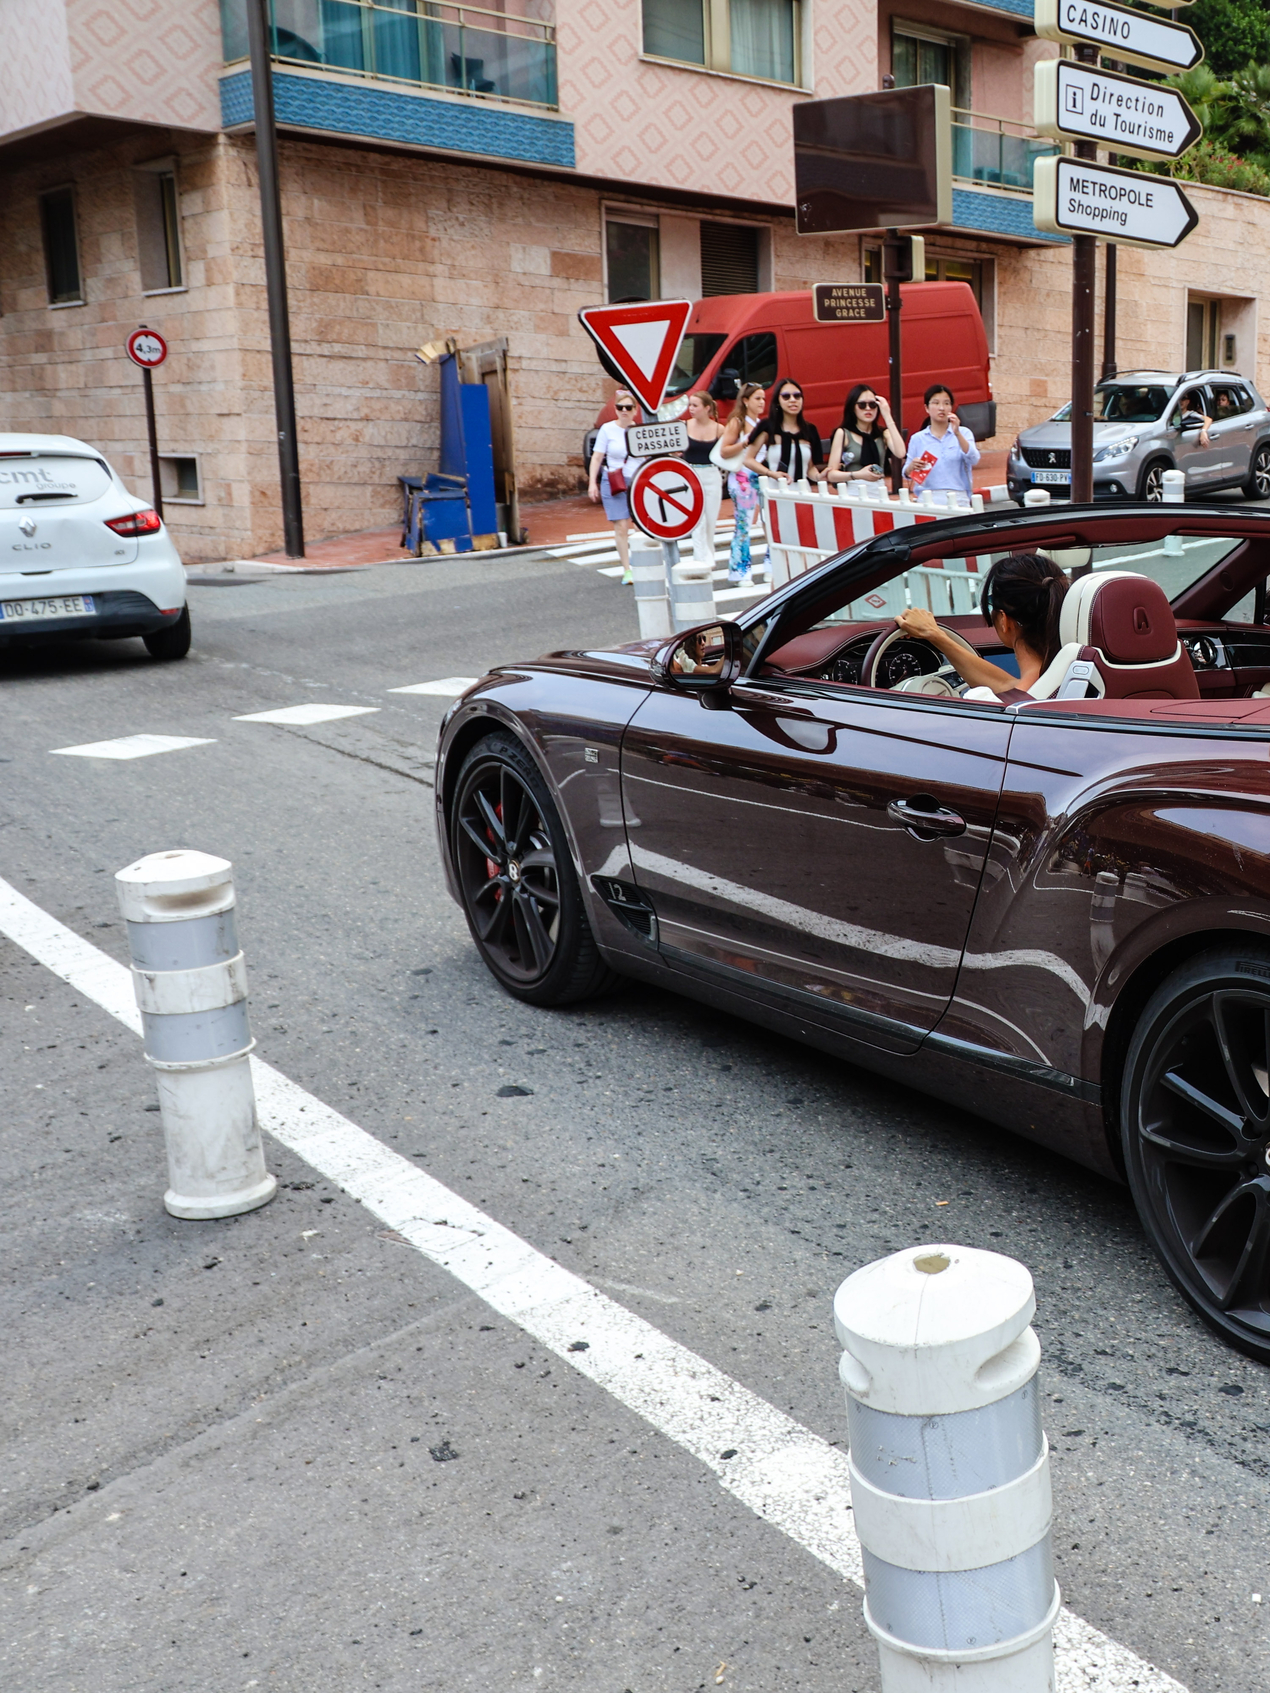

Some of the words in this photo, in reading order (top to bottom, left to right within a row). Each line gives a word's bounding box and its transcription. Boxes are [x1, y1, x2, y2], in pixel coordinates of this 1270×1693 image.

[1066, 4, 1131, 40] CASINO
[1090, 82, 1164, 118] Direction
[1089, 109, 1106, 128] du
[1113, 113, 1174, 144] Tourisme
[1069, 177, 1154, 208] METROPOLE
[1067, 197, 1128, 226] Shopping
[832, 288, 867, 297] AVENUE
[824, 298, 876, 307] PRINCESSE
[835, 308, 866, 317] GRACE
[135, 343, 162, 354] 4,3m
[635, 427, 667, 440] CÉDEZ
[669, 426, 680, 436] LE
[637, 438, 682, 451] PASSAGE
[36, 483, 76, 491] groupe
[12, 542, 52, 551] CLIO
